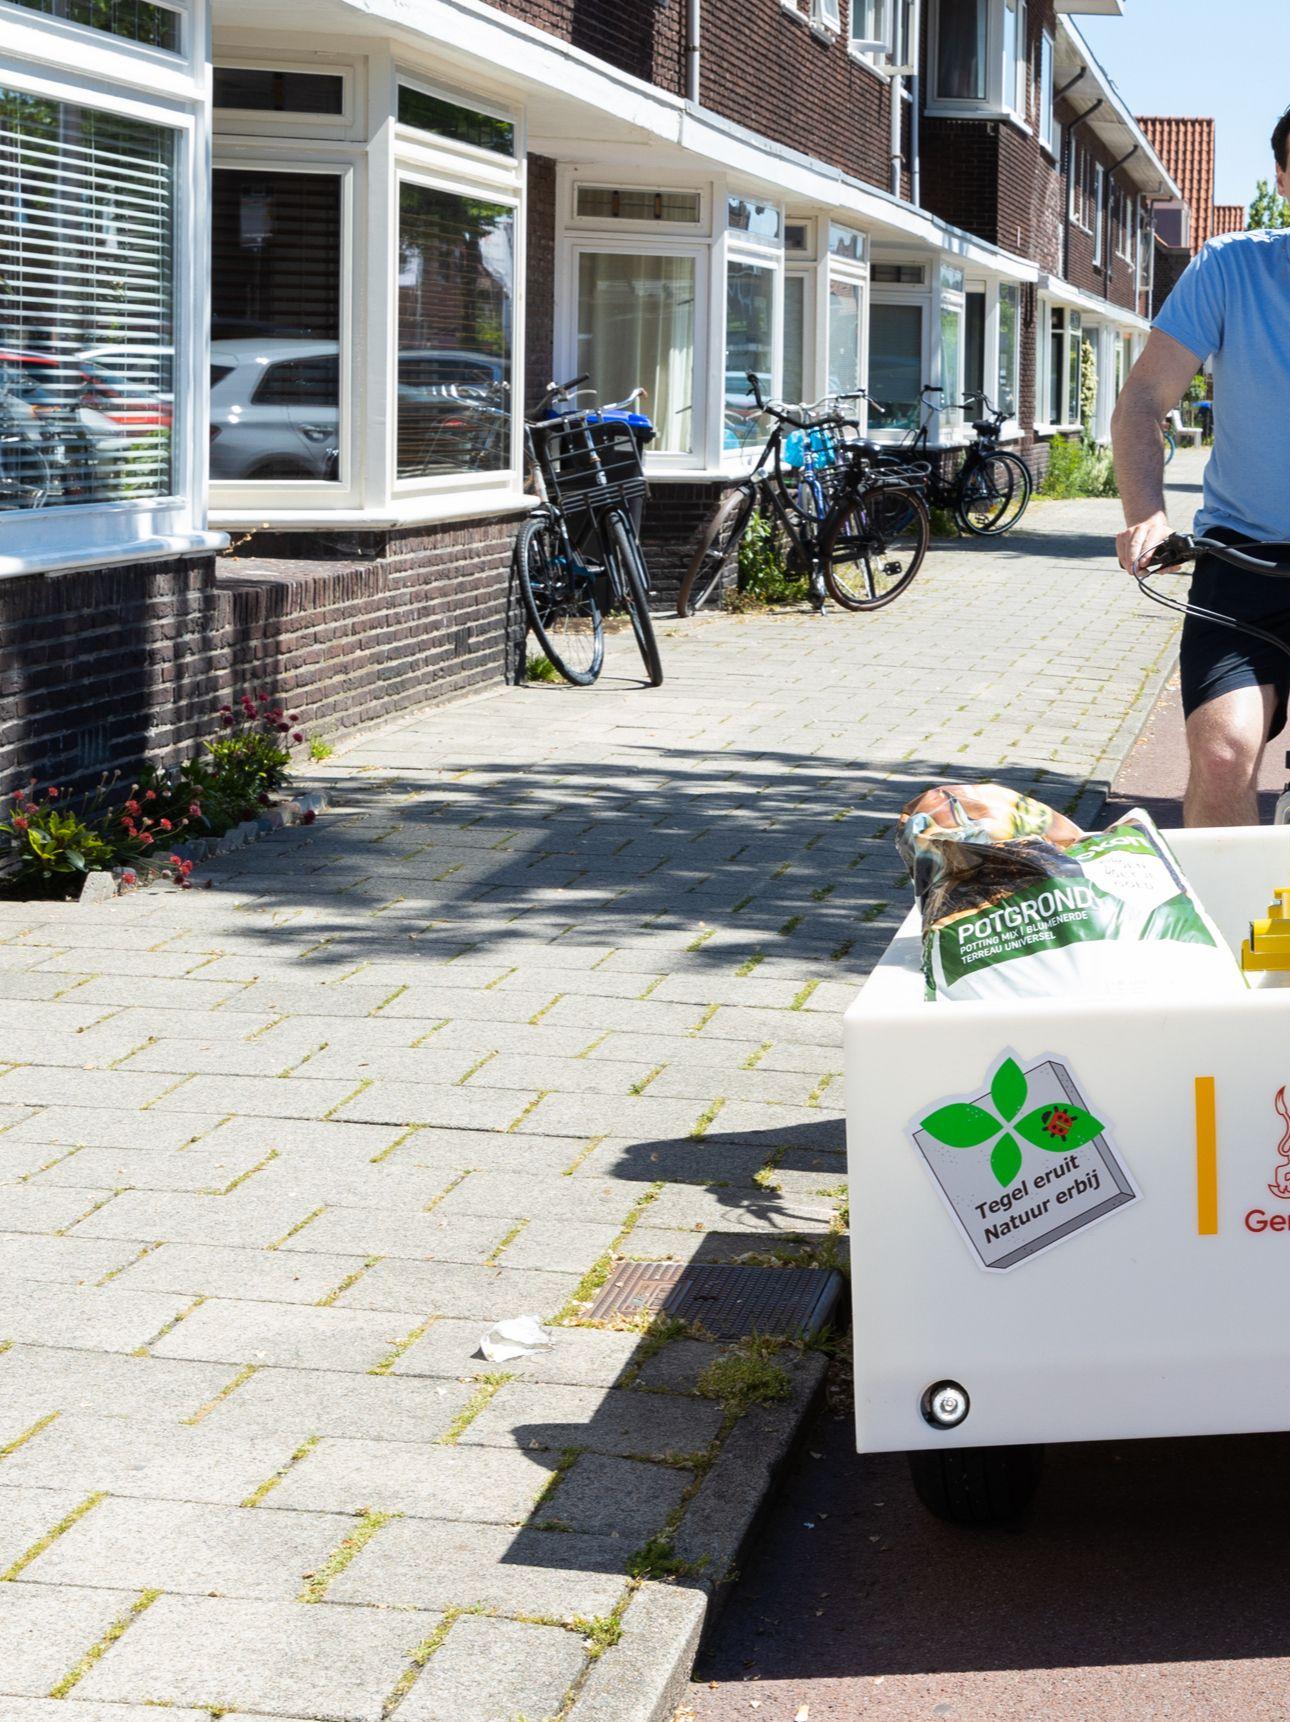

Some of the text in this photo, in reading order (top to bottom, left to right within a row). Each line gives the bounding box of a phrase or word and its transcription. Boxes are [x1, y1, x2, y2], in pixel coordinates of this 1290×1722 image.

[957, 886, 1093, 945] POTGROND
[959, 910, 1089, 955] POTTING MIX BLUMENERDE
[961, 930, 1057, 965] TERREAU UNIVERSEL
[974, 1154, 1080, 1220] Tegel eruit
[983, 1169, 1101, 1244] Natuur erbij
